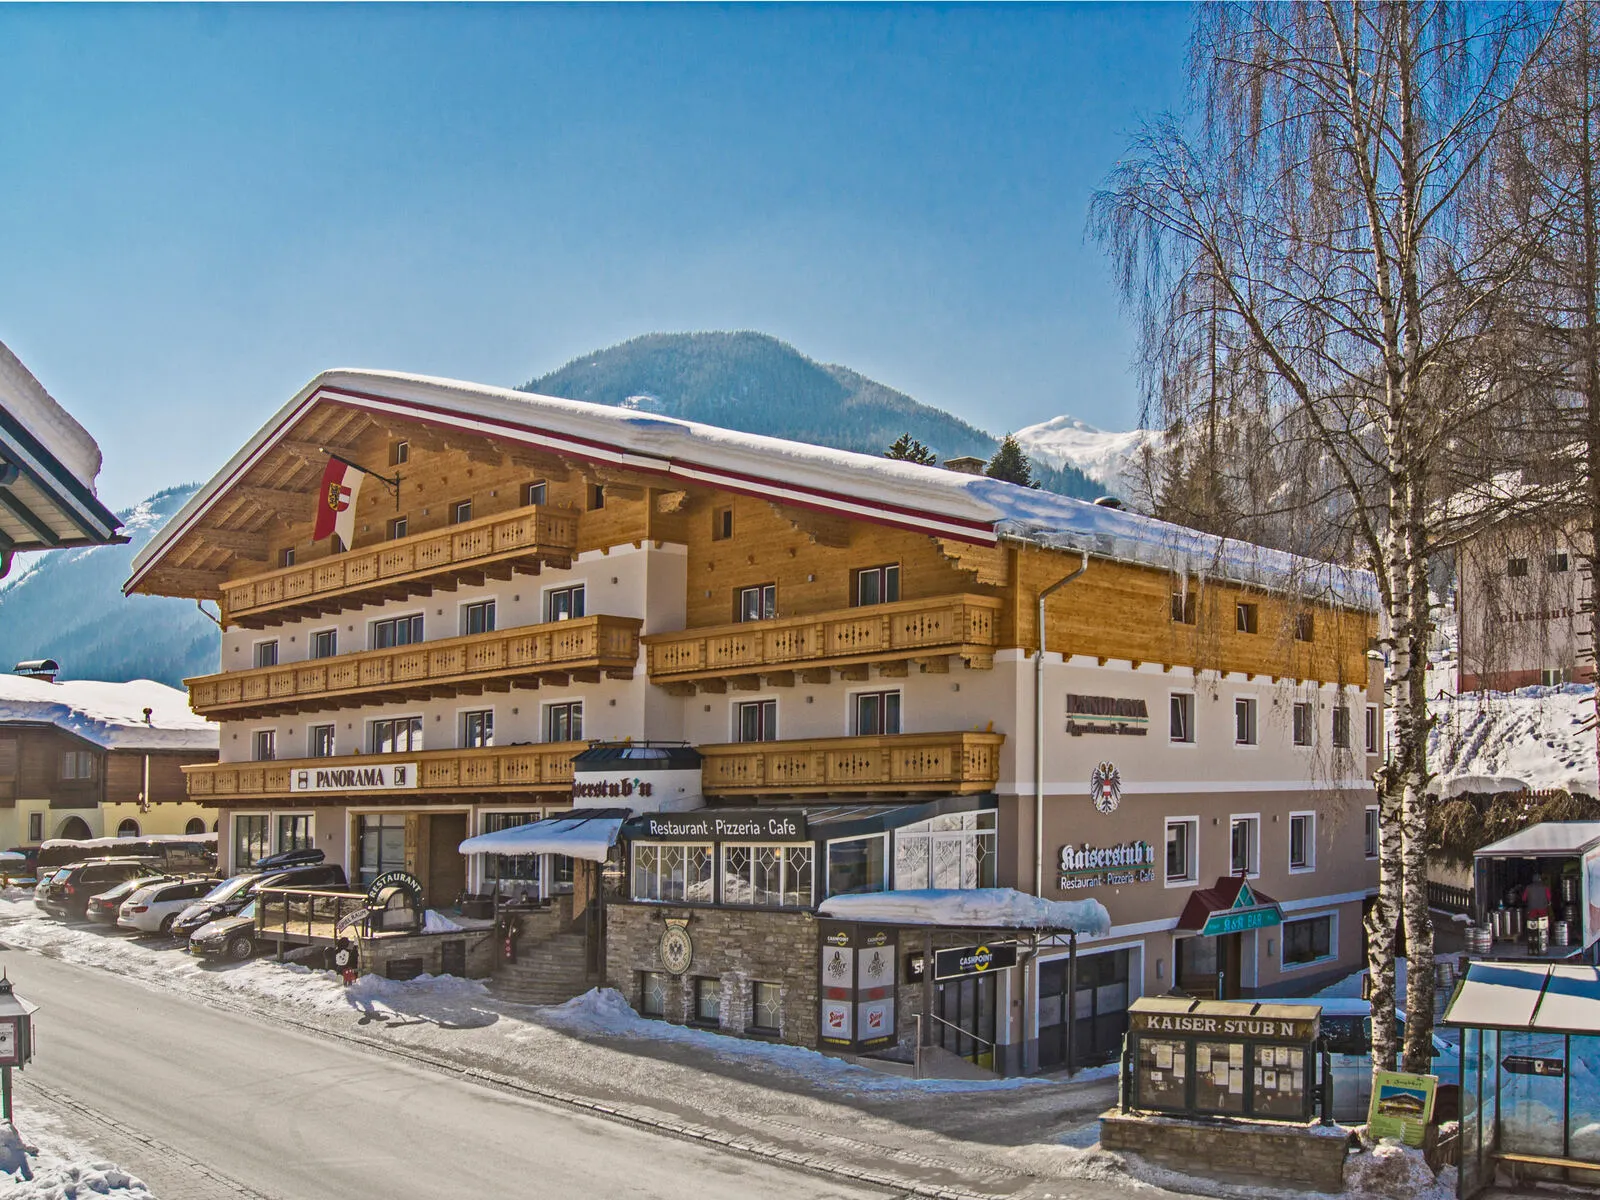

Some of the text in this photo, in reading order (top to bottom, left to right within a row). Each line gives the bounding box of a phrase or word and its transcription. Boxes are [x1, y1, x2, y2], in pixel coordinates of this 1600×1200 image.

[316, 768, 385, 788] PANORAMA
[650, 818, 796, 835] Restaurant Pizzeria Cafe
[369, 873, 422, 898] RESTAURANT
[1060, 875, 1102, 890] Restaurant
[1107, 872, 1134, 885] Pizzeria
[960, 953, 993, 966] CASHPOINT
[1147, 1015, 1216, 1032] KAISER
